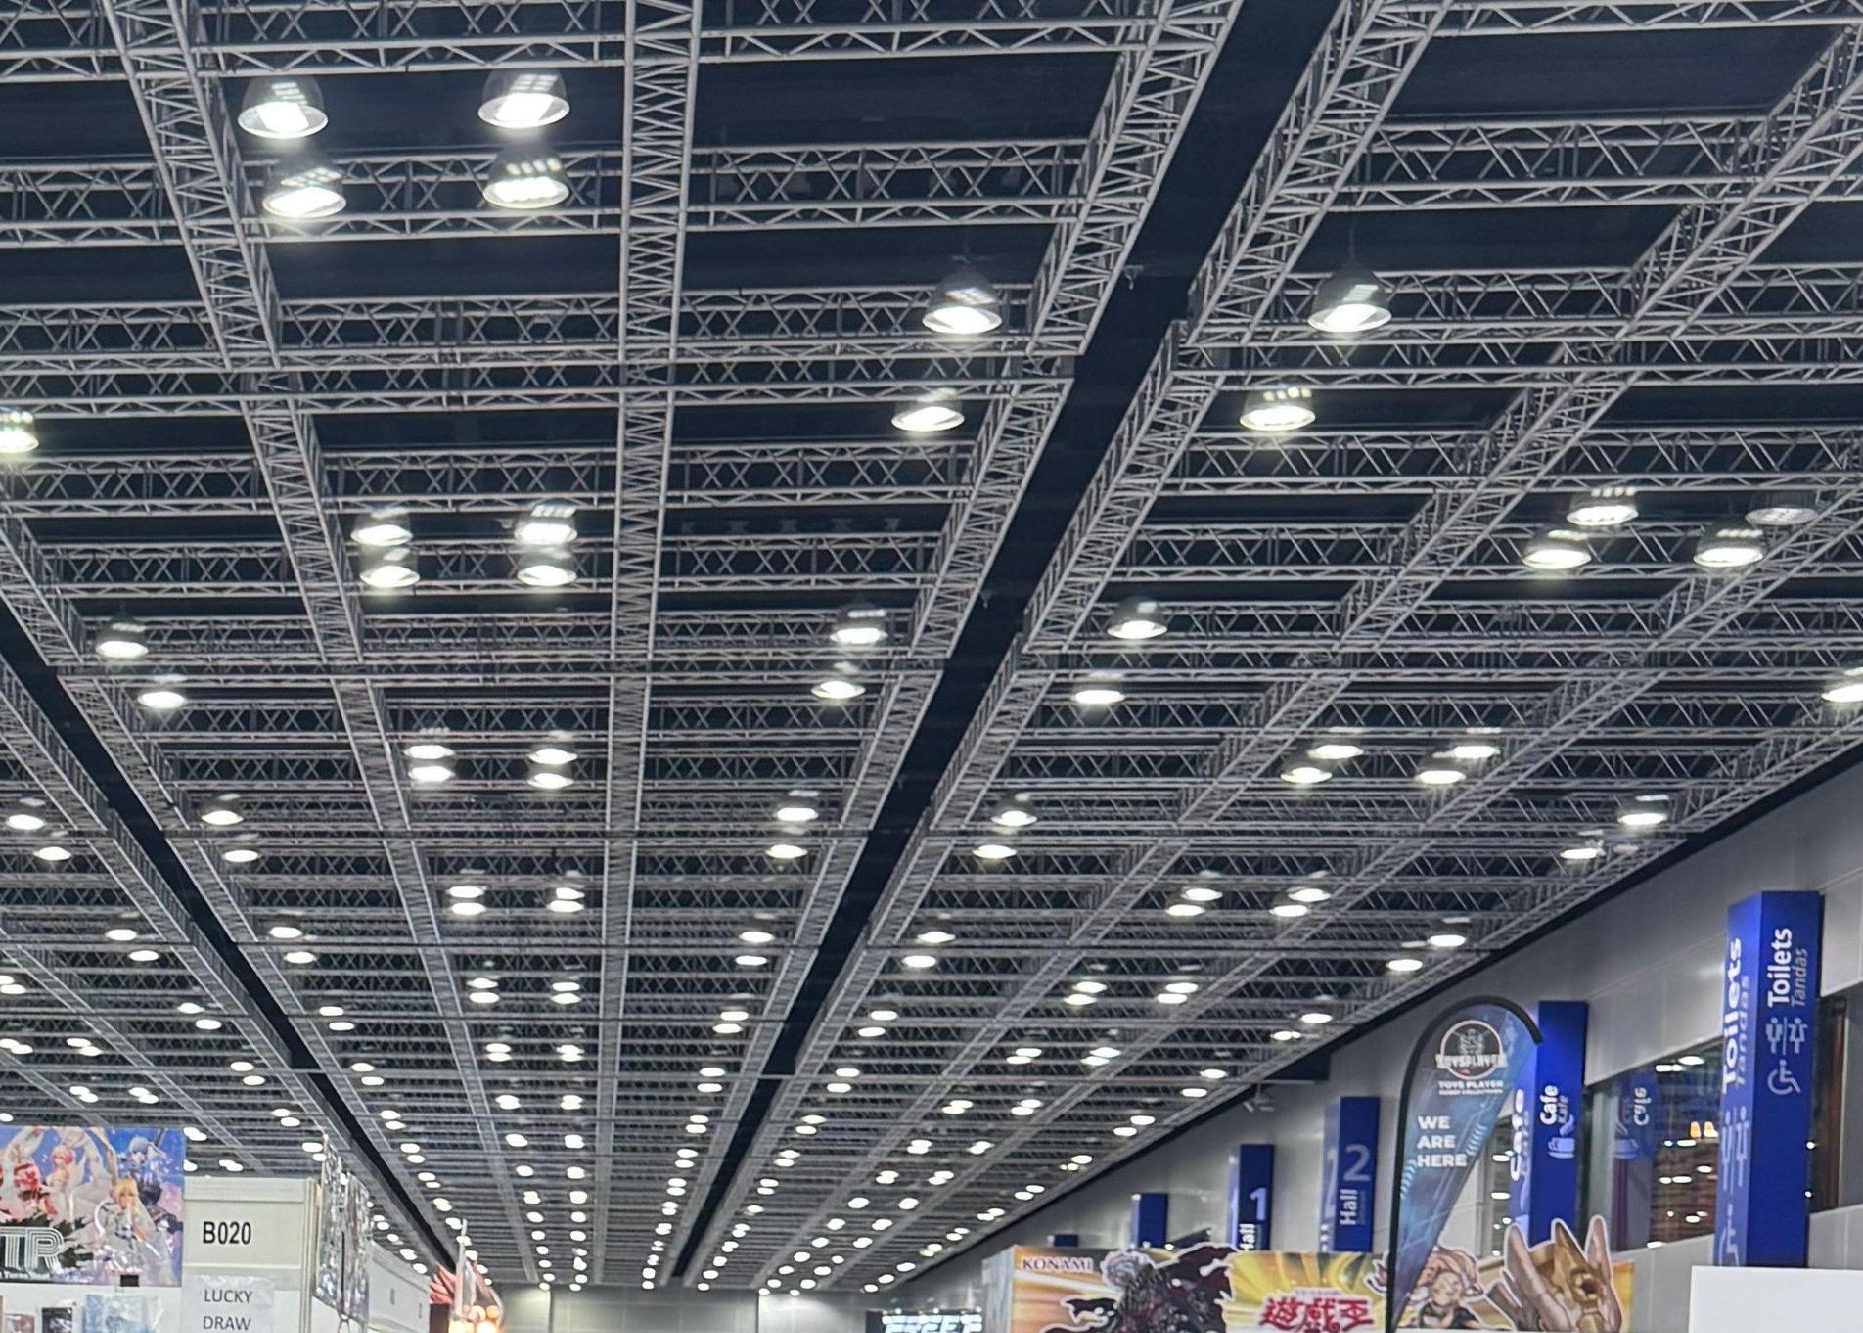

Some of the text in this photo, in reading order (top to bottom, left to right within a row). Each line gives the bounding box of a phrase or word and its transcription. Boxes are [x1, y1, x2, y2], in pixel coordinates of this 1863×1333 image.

[1767, 928, 1793, 1008] Toilets
[1791, 948, 1807, 1007] Tandas
[1438, 1080, 1504, 1088] TOYS PLAYER
[1539, 1085, 1559, 1125] Cafe
[1418, 1116, 1450, 1129] WE
[1417, 1135, 1456, 1149] ARE
[1343, 1144, 1371, 1182] 2
[1417, 1154, 1468, 1167] HERE
[1249, 1187, 1267, 1221] 1
[1339, 1189, 1358, 1225] Hall
[202, 1220, 252, 1246] B020
[1022, 1257, 1094, 1273] KONAMI
[203, 1289, 253, 1305] LUCKY
[203, 1315, 252, 1332] DRAW
